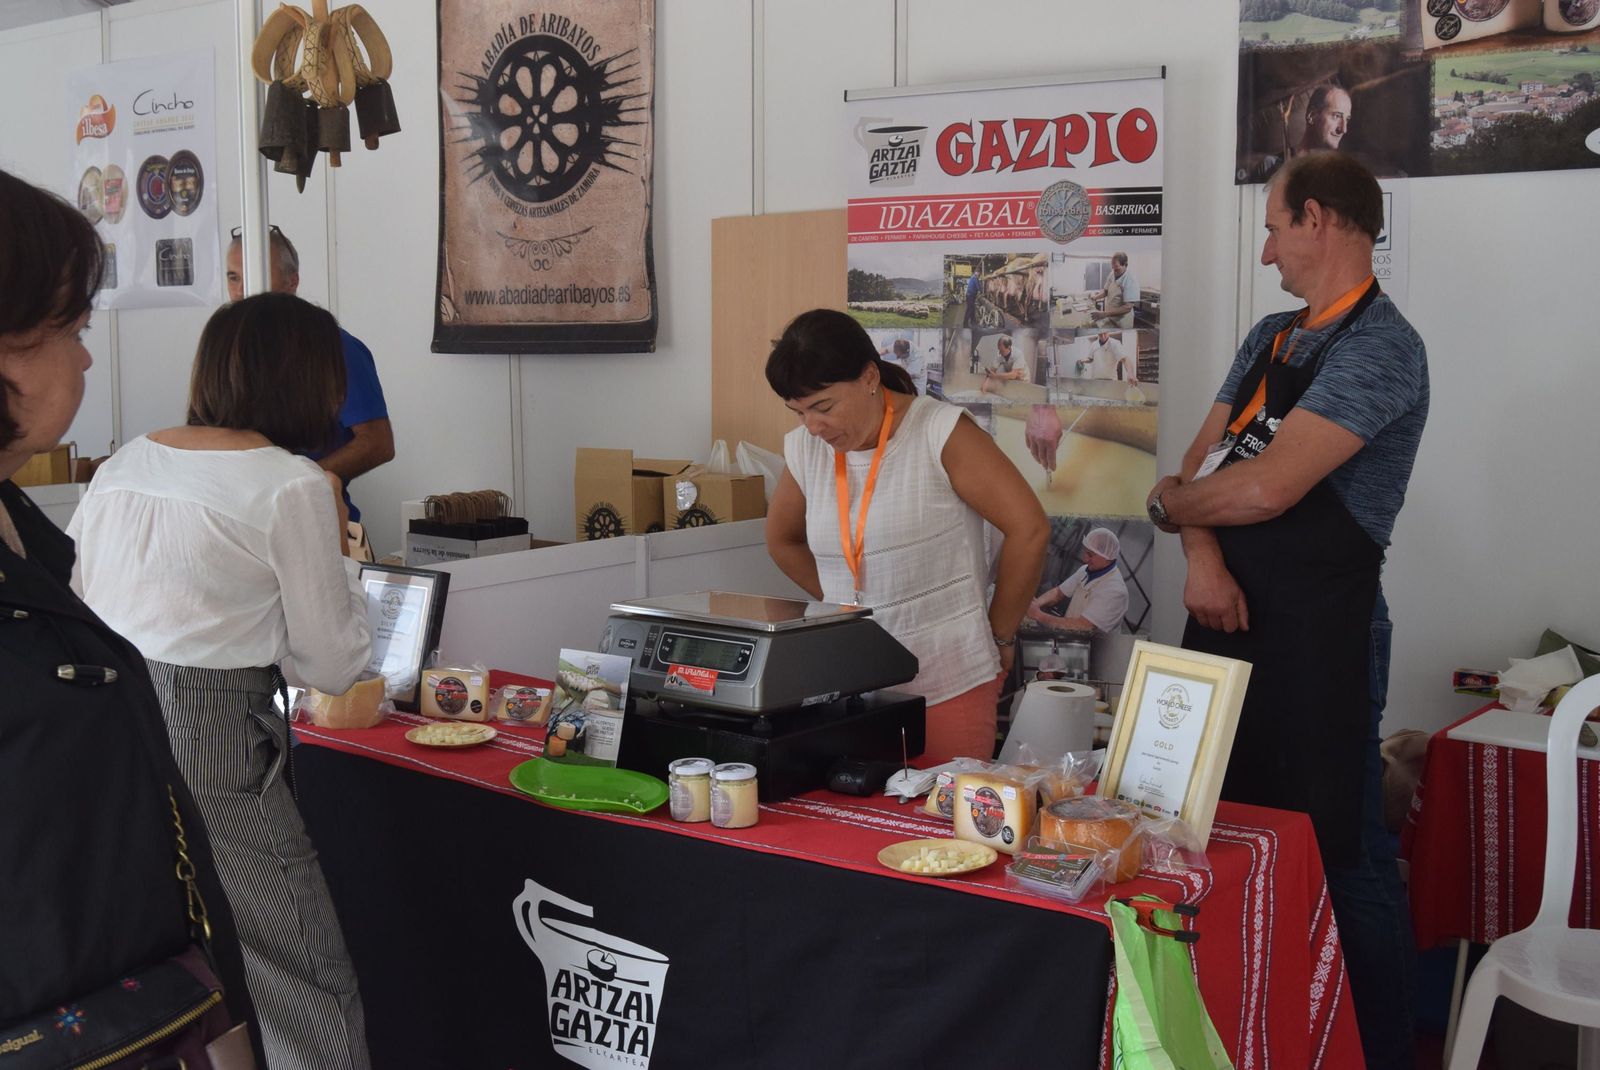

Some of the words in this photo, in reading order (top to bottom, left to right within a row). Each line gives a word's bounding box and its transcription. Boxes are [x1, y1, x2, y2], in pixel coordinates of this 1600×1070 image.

[480, 19, 517, 75] ABADÍA
[519, 13, 536, 35] DE
[539, 12, 602, 62] ARIBAYOS
[133, 89, 194, 116] Cincho
[82, 118, 107, 136] ilbesa
[870, 144, 921, 164] ARTZAI
[936, 107, 1158, 177] GAZPIO
[869, 158, 917, 180] GAZTA
[503, 196, 528, 217] CERVEZAS
[528, 197, 570, 218] ARTESANALES
[567, 191, 581, 206] DE
[576, 167, 601, 199] ZAMORA
[1095, 204, 1160, 216] BASERRIKOA
[463, 282, 631, 309] www.abadiadearibayos.es
[1153, 740, 1174, 751] GOLD
[551, 969, 655, 1025] ARTZAI
[550, 1001, 649, 1057] GAZTA
